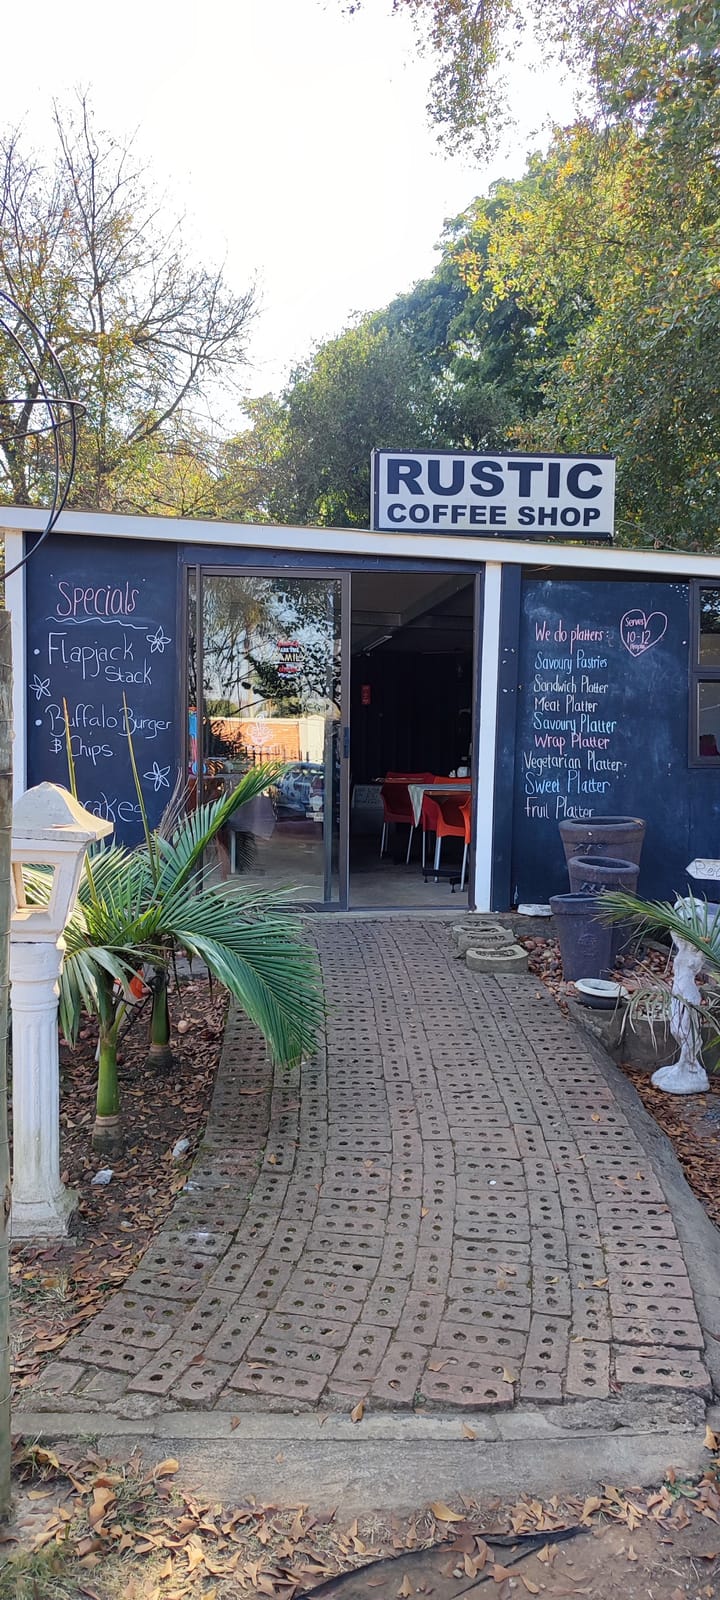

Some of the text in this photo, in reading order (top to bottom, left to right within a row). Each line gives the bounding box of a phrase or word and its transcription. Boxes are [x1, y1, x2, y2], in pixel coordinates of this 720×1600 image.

[387, 458, 603, 499] RUSTIC
[387, 503, 601, 526] COFFEE SHOP
[57, 581, 139, 616] Specials
[535, 620, 551, 641] We
[554, 619, 567, 642] do
[48, 632, 134, 680] Flapjack
[535, 649, 608, 674] Savoury Pastries
[105, 657, 152, 685] Stack
[533, 674, 608, 694] Sandwich Platter
[534, 694, 598, 714] Meat Platter
[45, 704, 172, 739] Buffalo Burger
[533, 711, 617, 736] Savoury Platter
[66, 735, 114, 766] Chips
[534, 732, 610, 755] Wrap Platter
[523, 749, 622, 776] Vegetarian Platter
[525, 770, 610, 795] Sweet Platter
[524, 795, 595, 820] Fruit Platter
